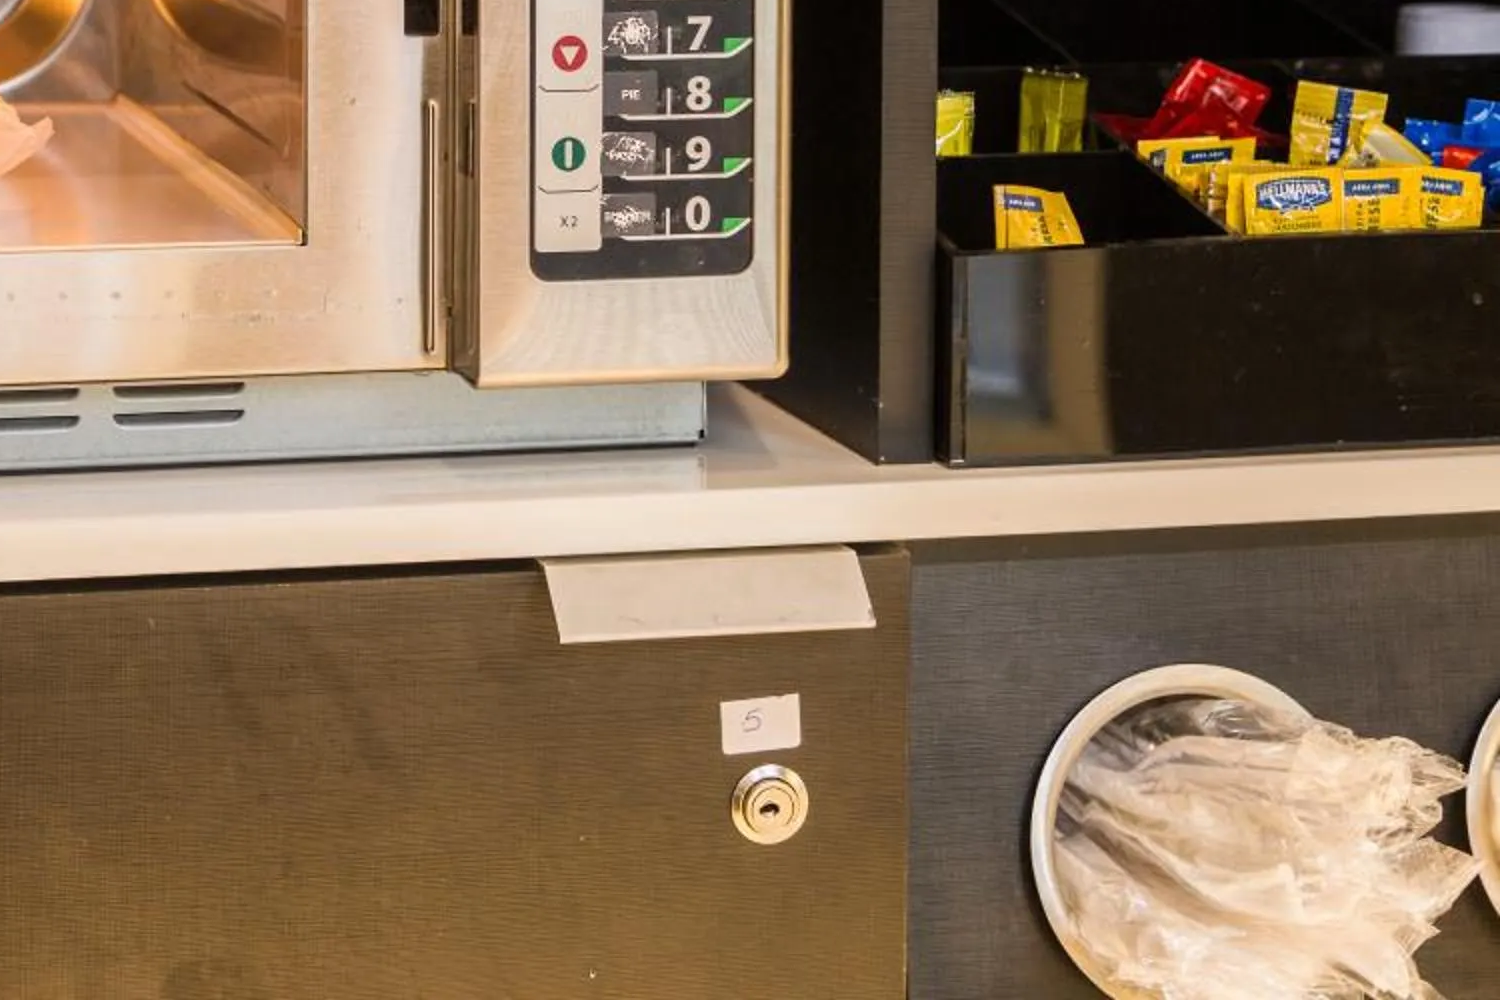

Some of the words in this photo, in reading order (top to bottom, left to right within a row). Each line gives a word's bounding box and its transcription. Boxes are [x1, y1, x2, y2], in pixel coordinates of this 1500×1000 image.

[686, 15, 714, 52] 7
[621, 89, 642, 101] PIE
[685, 75, 713, 112] 8
[685, 136, 712, 172] 9
[684, 196, 712, 232] 0
